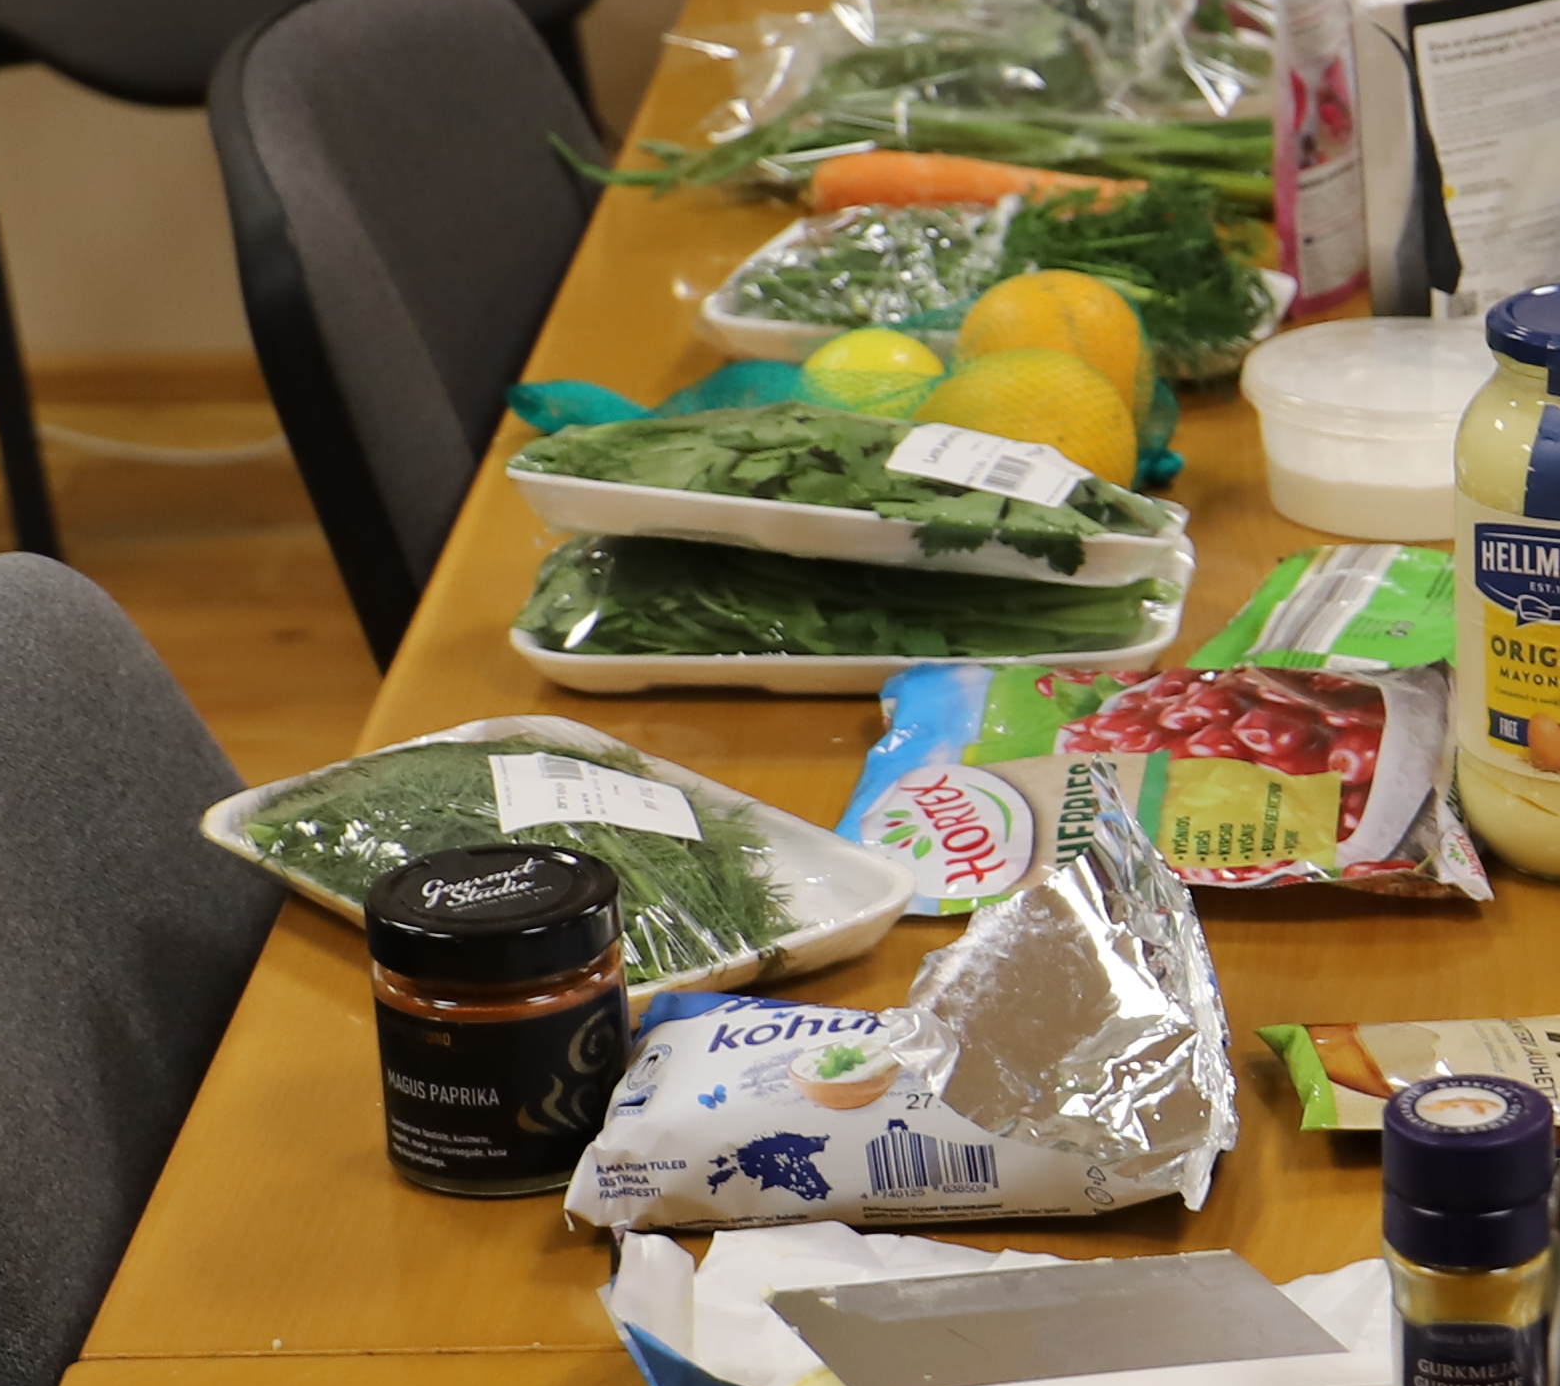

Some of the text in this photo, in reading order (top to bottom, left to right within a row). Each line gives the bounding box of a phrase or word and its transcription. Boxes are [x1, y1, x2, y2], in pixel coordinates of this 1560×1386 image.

[1498, 716, 1520, 742] FREE
[900, 773, 1007, 885] HORTEX
[421, 857, 546, 909] Gourmet
[446, 877, 535, 907] Studio
[387, 1067, 500, 1106] MAGUS PAPRIKA
[650, 1159, 687, 1171] TULEB
[1416, 1357, 1520, 1380] GURKMEJA
